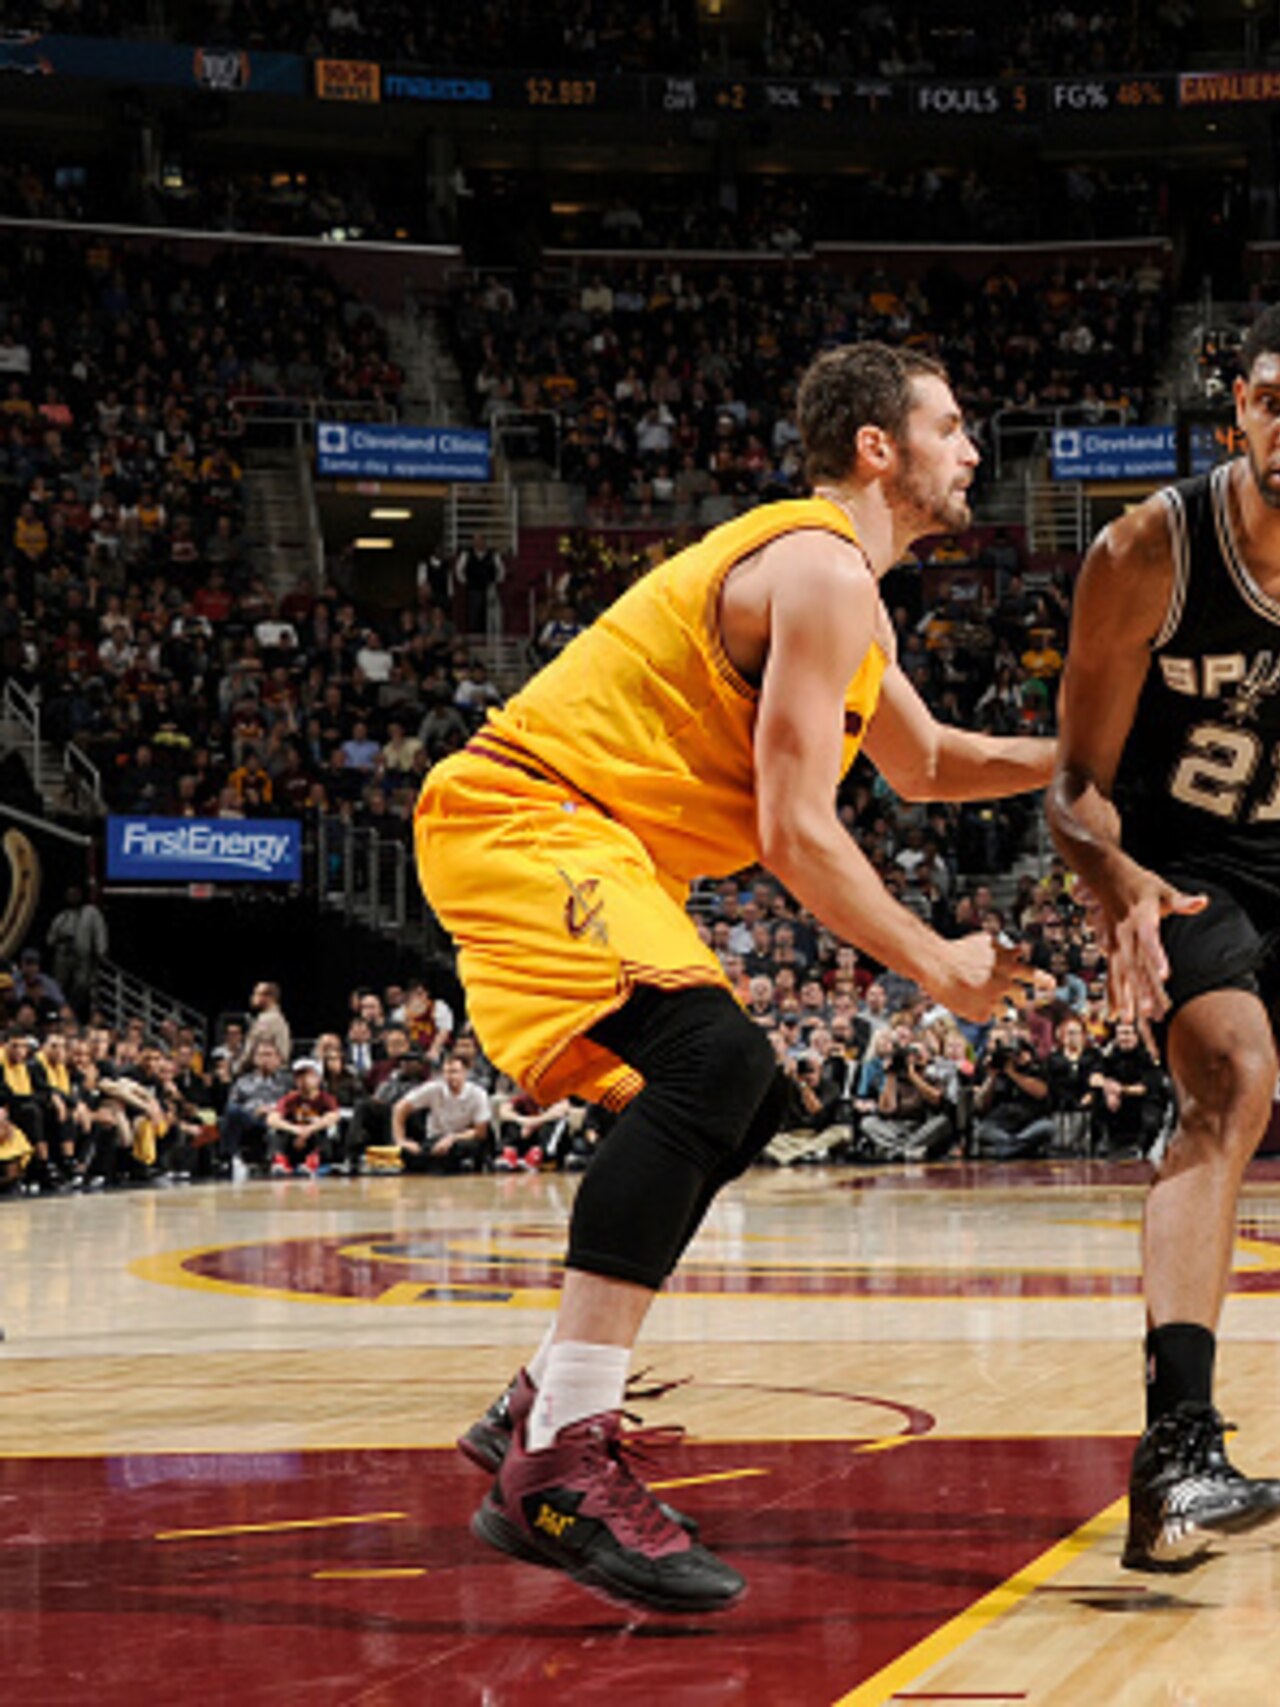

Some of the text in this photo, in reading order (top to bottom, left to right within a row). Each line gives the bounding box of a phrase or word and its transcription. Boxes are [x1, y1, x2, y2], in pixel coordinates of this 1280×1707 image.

[918, 86, 1000, 114] FOULS
[1054, 84, 1109, 112] FG%
[352, 431, 436, 453] Cleveland
[1085, 435, 1165, 453] Cleveland
[123, 823, 290, 864] FirstEnergy
